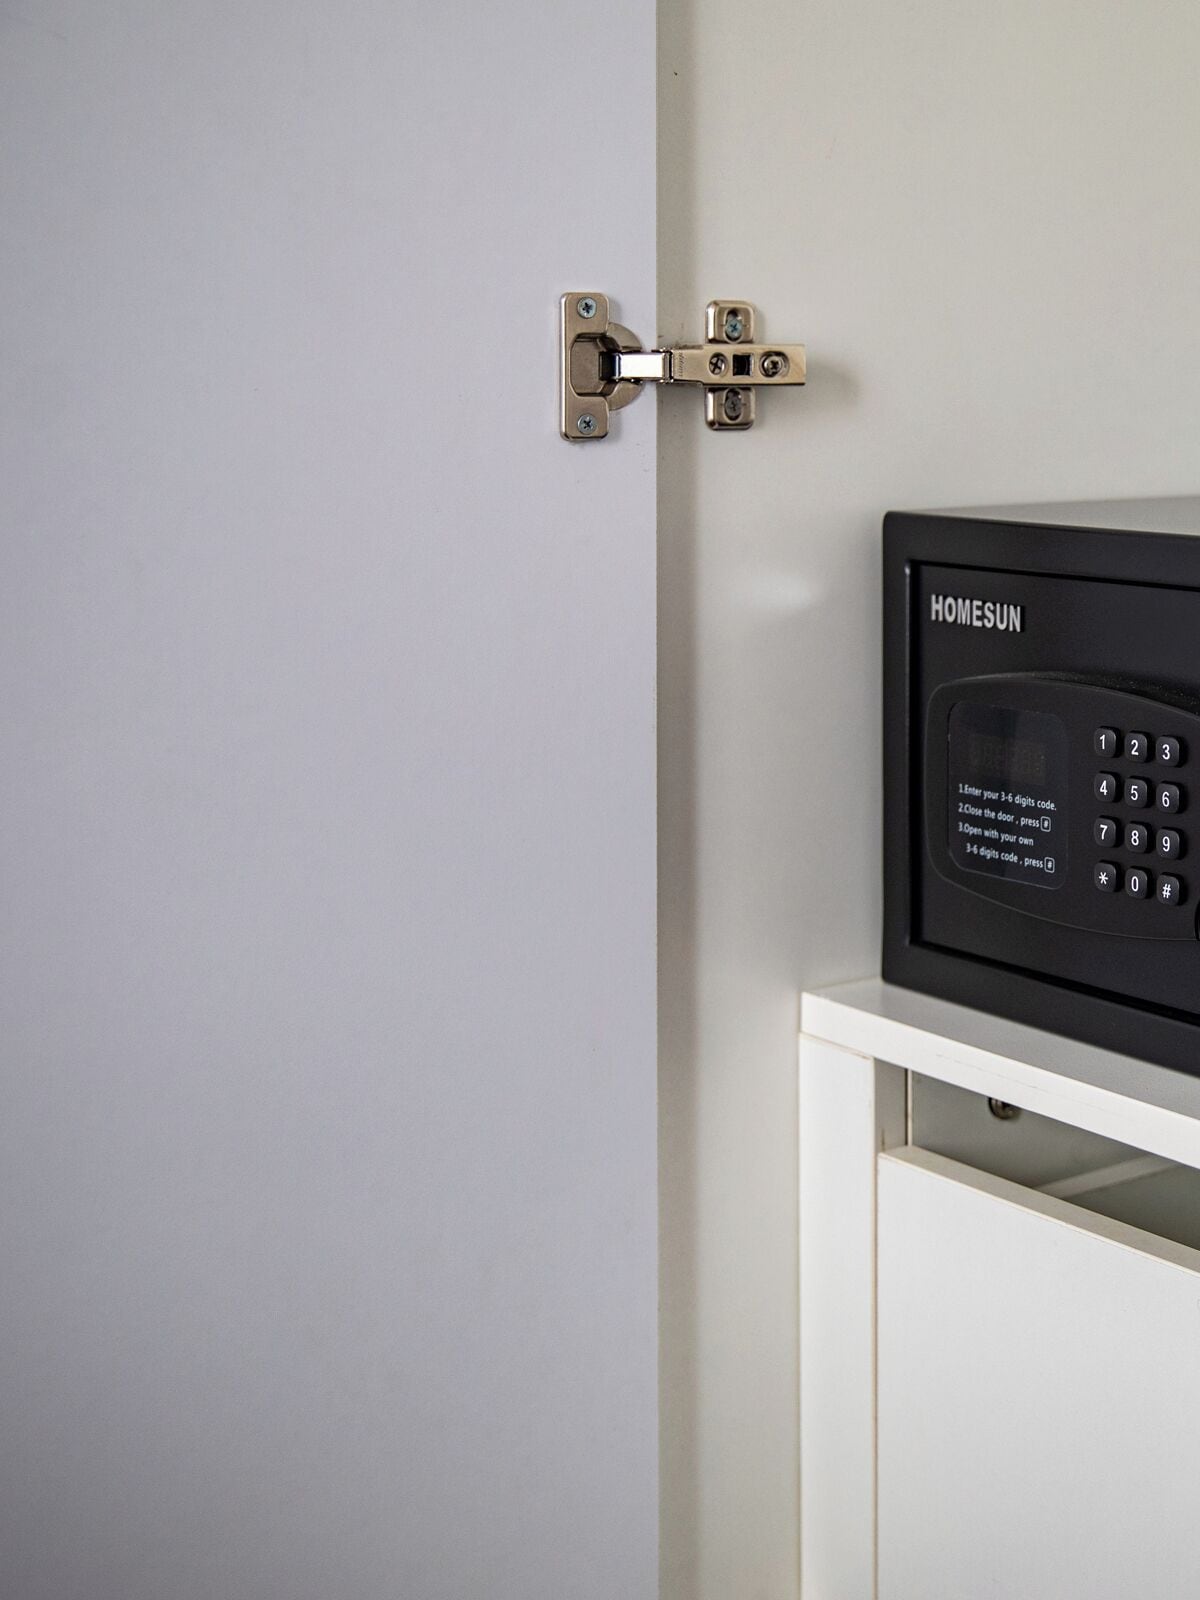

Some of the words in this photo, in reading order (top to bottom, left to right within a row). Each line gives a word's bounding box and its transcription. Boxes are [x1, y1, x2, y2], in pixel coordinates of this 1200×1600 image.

[931, 594, 1022, 632] HOMESUN
[1099, 734, 1106, 750] 1
[1131, 739, 1139, 756] 2
[1162, 744, 1170, 760] 3
[959, 784, 982, 796] 1.Enter
[983, 789, 999, 800] your
[1001, 792, 1012, 802] 3-6
[1015, 795, 1035, 807] digits
[1037, 800, 1057, 811] code.
[1099, 780, 1108, 796] 4
[1131, 786, 1138, 801] 5
[1162, 791, 1170, 807] 6
[958, 803, 982, 816] 2.Close
[984, 808, 995, 819] the
[997, 811, 1014, 822] door
[1021, 817, 1039, 828] press
[958, 822, 982, 836] 3.Open
[984, 828, 998, 839] with
[1000, 833, 1016, 842] your
[1019, 836, 1034, 846] own
[1100, 825, 1108, 840] 7
[1131, 830, 1139, 845] 8
[1162, 837, 1170, 852] 9
[966, 843, 978, 853] 3-6
[980, 846, 999, 859] digits
[1001, 851, 1018, 862] code
[1025, 857, 1043, 868] press
[1131, 876, 1138, 892] 0
[1162, 884, 1171, 898] #
